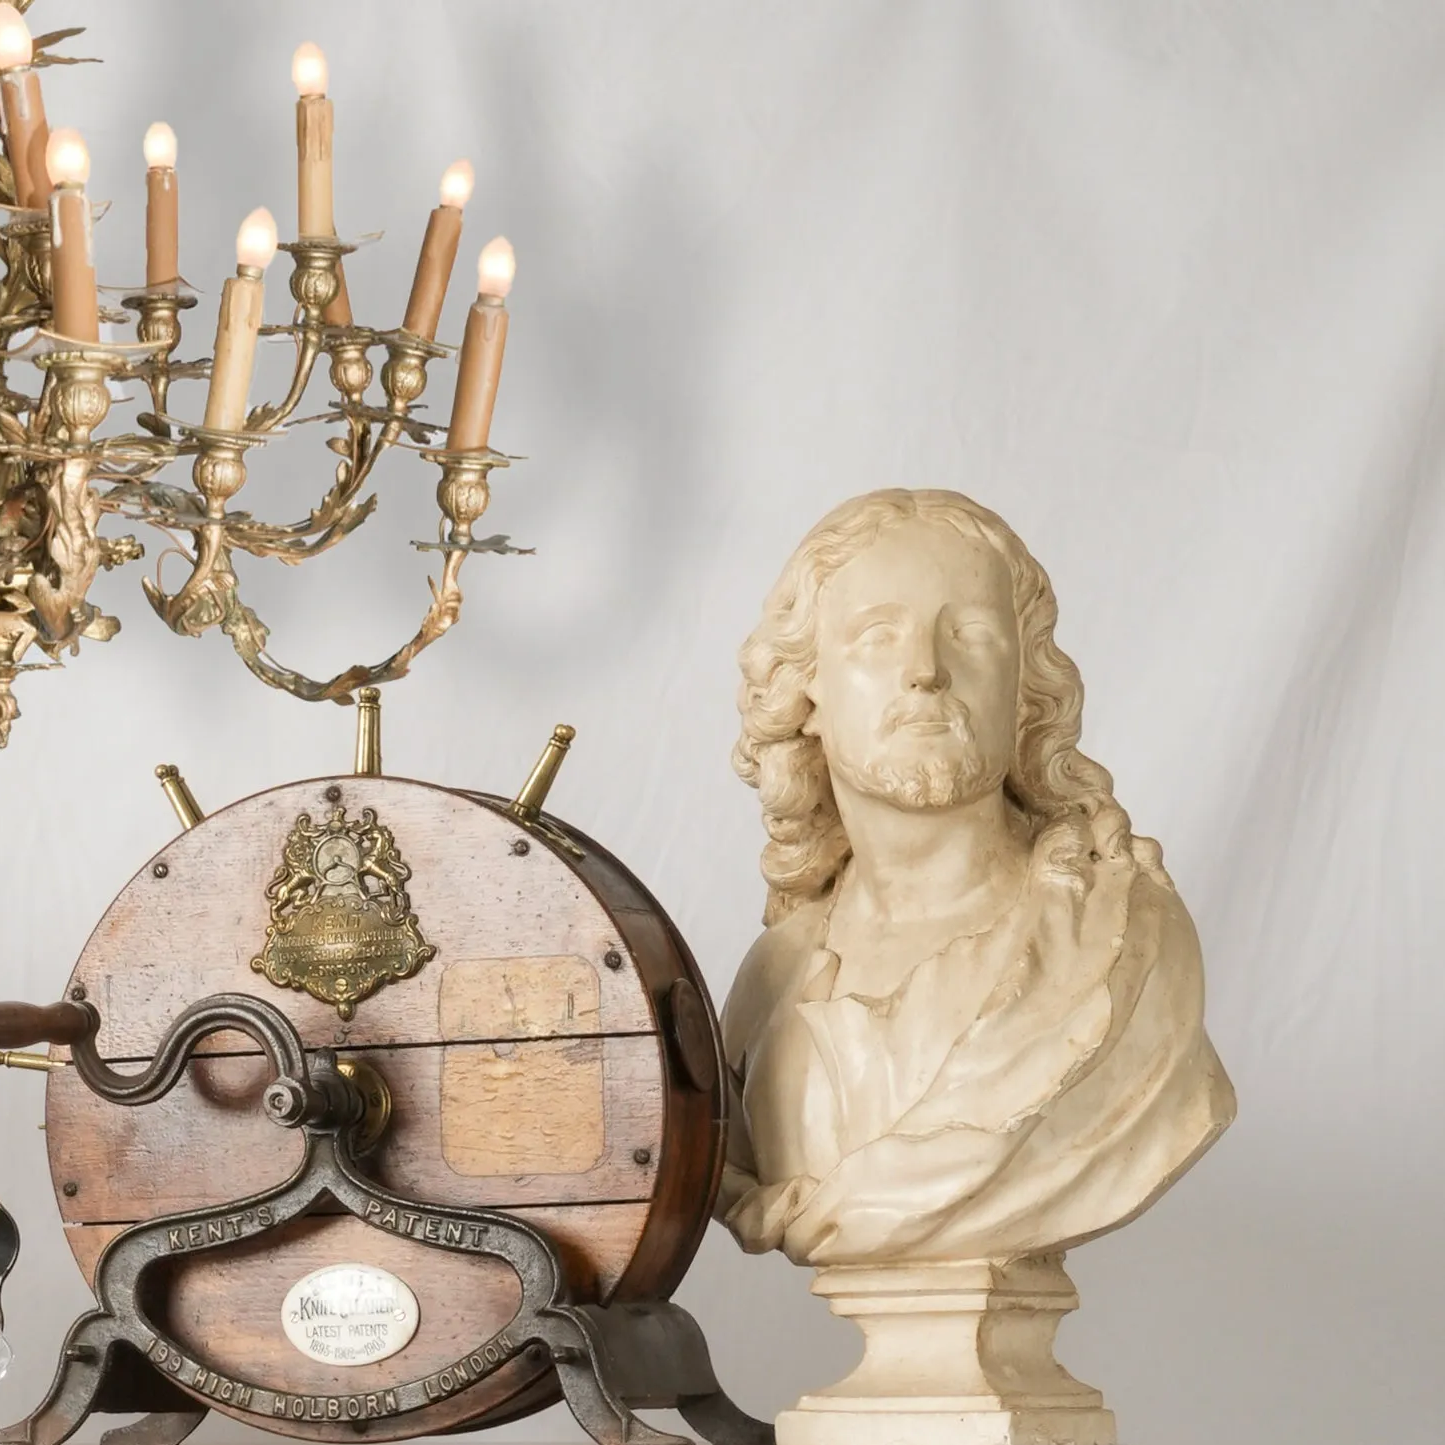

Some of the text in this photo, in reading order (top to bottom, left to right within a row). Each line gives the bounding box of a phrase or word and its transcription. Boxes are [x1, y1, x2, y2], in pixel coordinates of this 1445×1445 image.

[312, 913, 362, 930] KENT
[308, 961, 369, 977] LONDON
[167, 1200, 489, 1251] KENT'S PATENT
[305, 1323, 389, 1339] LATEST PATENTS
[145, 1334, 515, 1420] 199 HIGH HOLBORN LONDON
